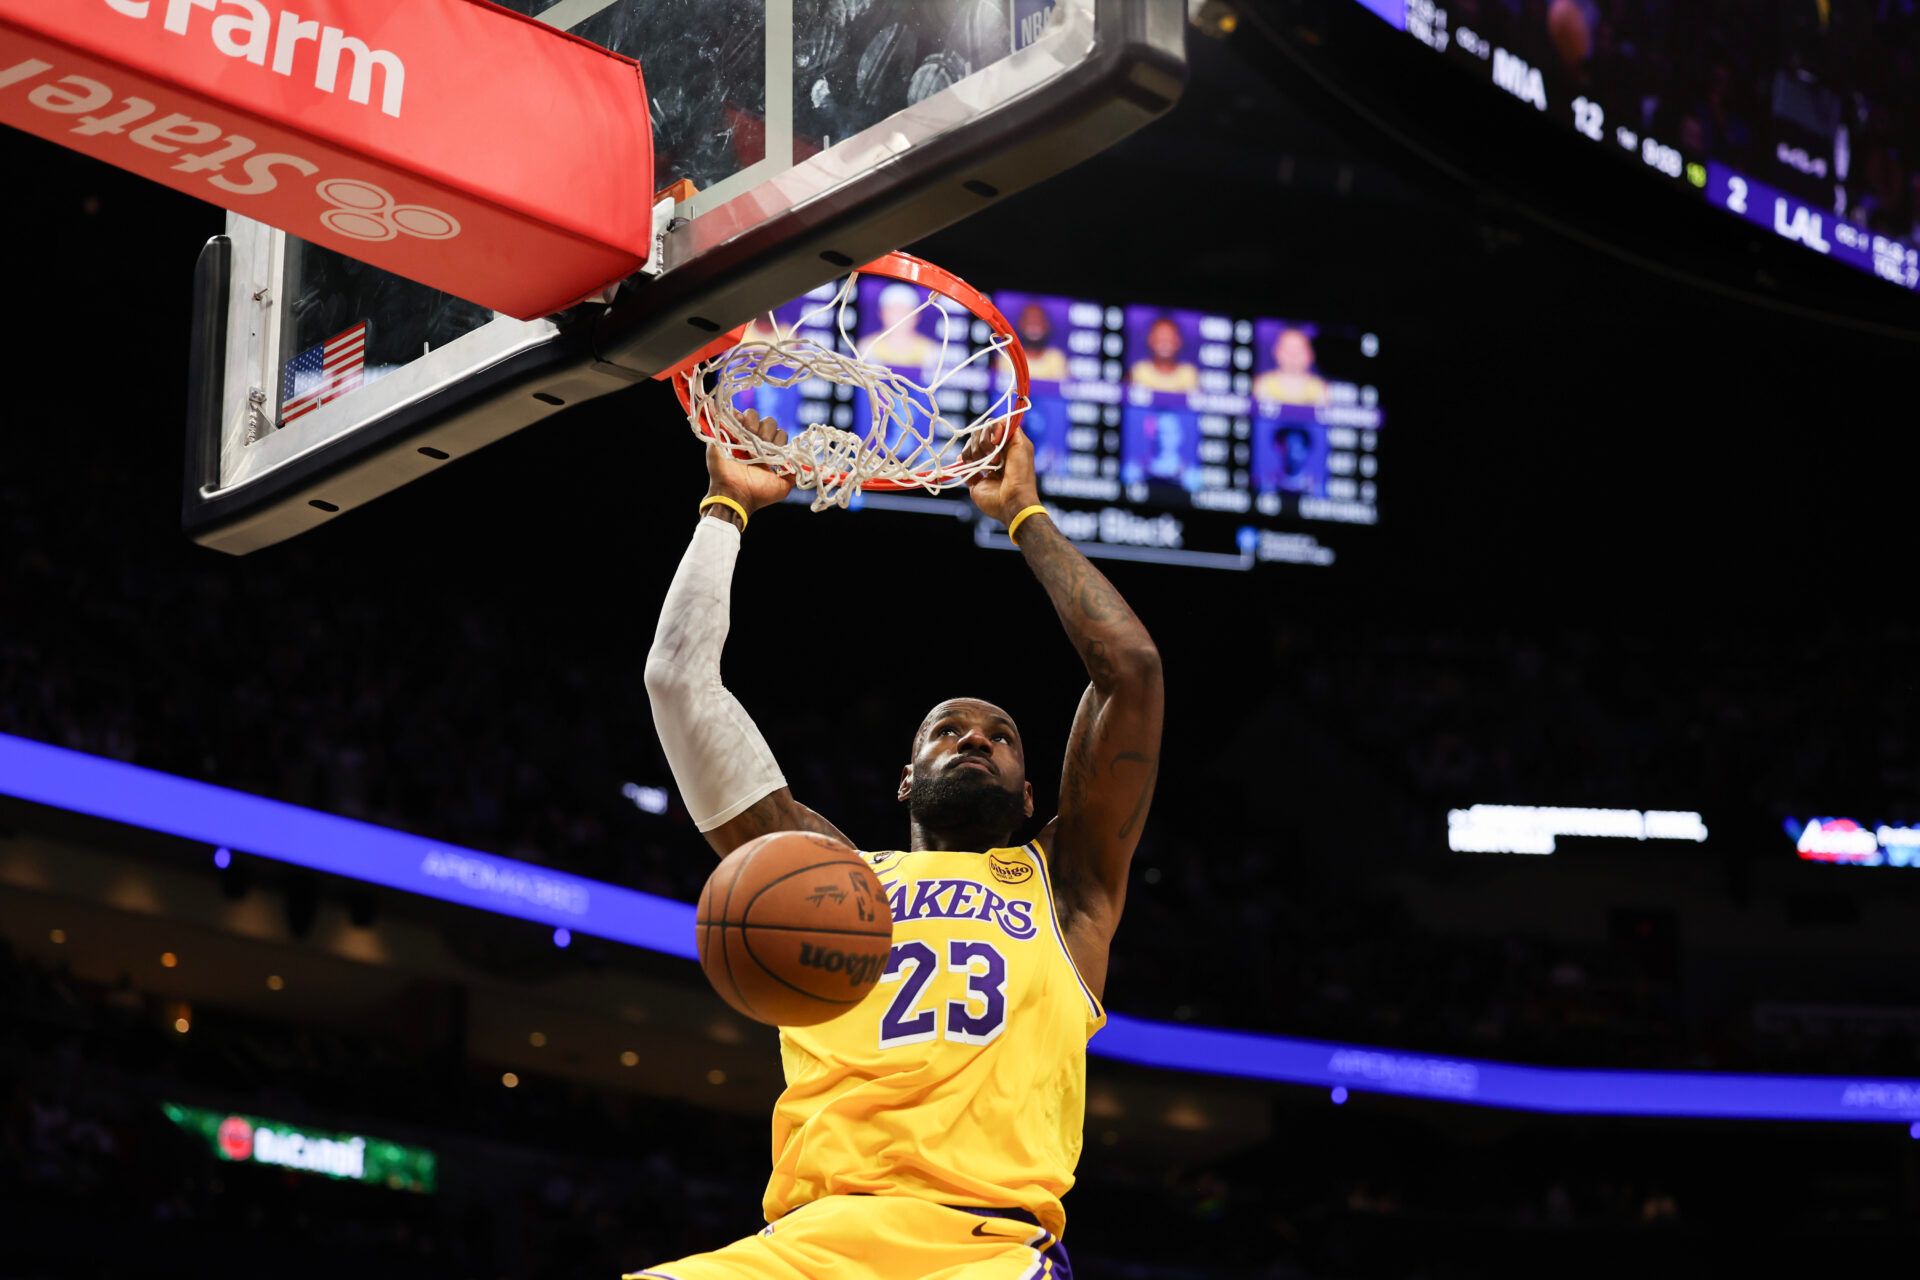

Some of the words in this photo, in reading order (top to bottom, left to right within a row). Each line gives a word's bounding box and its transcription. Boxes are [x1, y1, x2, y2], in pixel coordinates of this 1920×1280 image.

[103, 0, 405, 118] arm
[1571, 95, 1604, 142] 12
[1727, 176, 1748, 214] 2
[1774, 197, 1831, 254] LAL
[880, 879, 1037, 940] AKERS
[878, 939, 1008, 1050] 23
